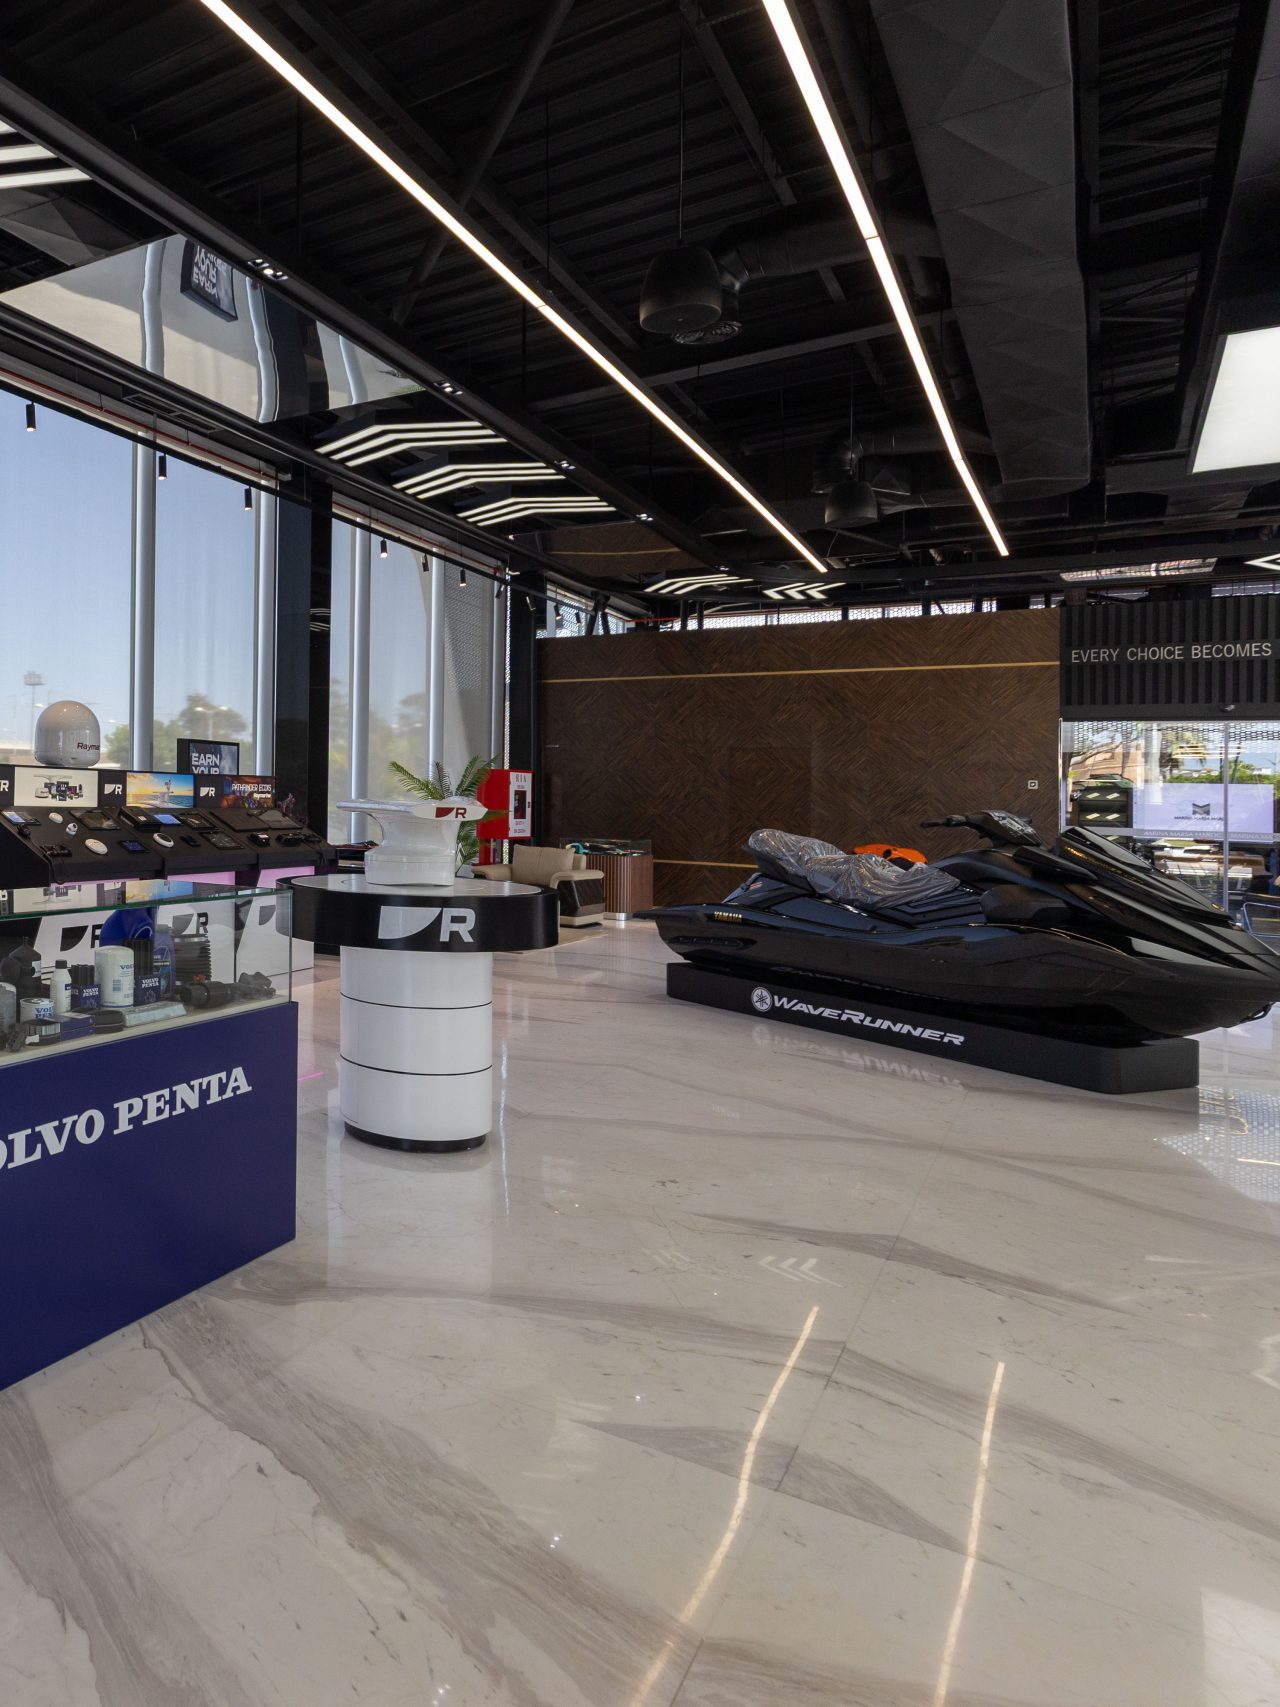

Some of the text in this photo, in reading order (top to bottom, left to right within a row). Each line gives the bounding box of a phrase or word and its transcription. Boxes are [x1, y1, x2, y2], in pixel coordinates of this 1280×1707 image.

[1071, 642, 1272, 663] EVERY CHOICE BECOMES
[191, 752, 220, 766] EARN
[113, 1066, 252, 1135] PENTA
